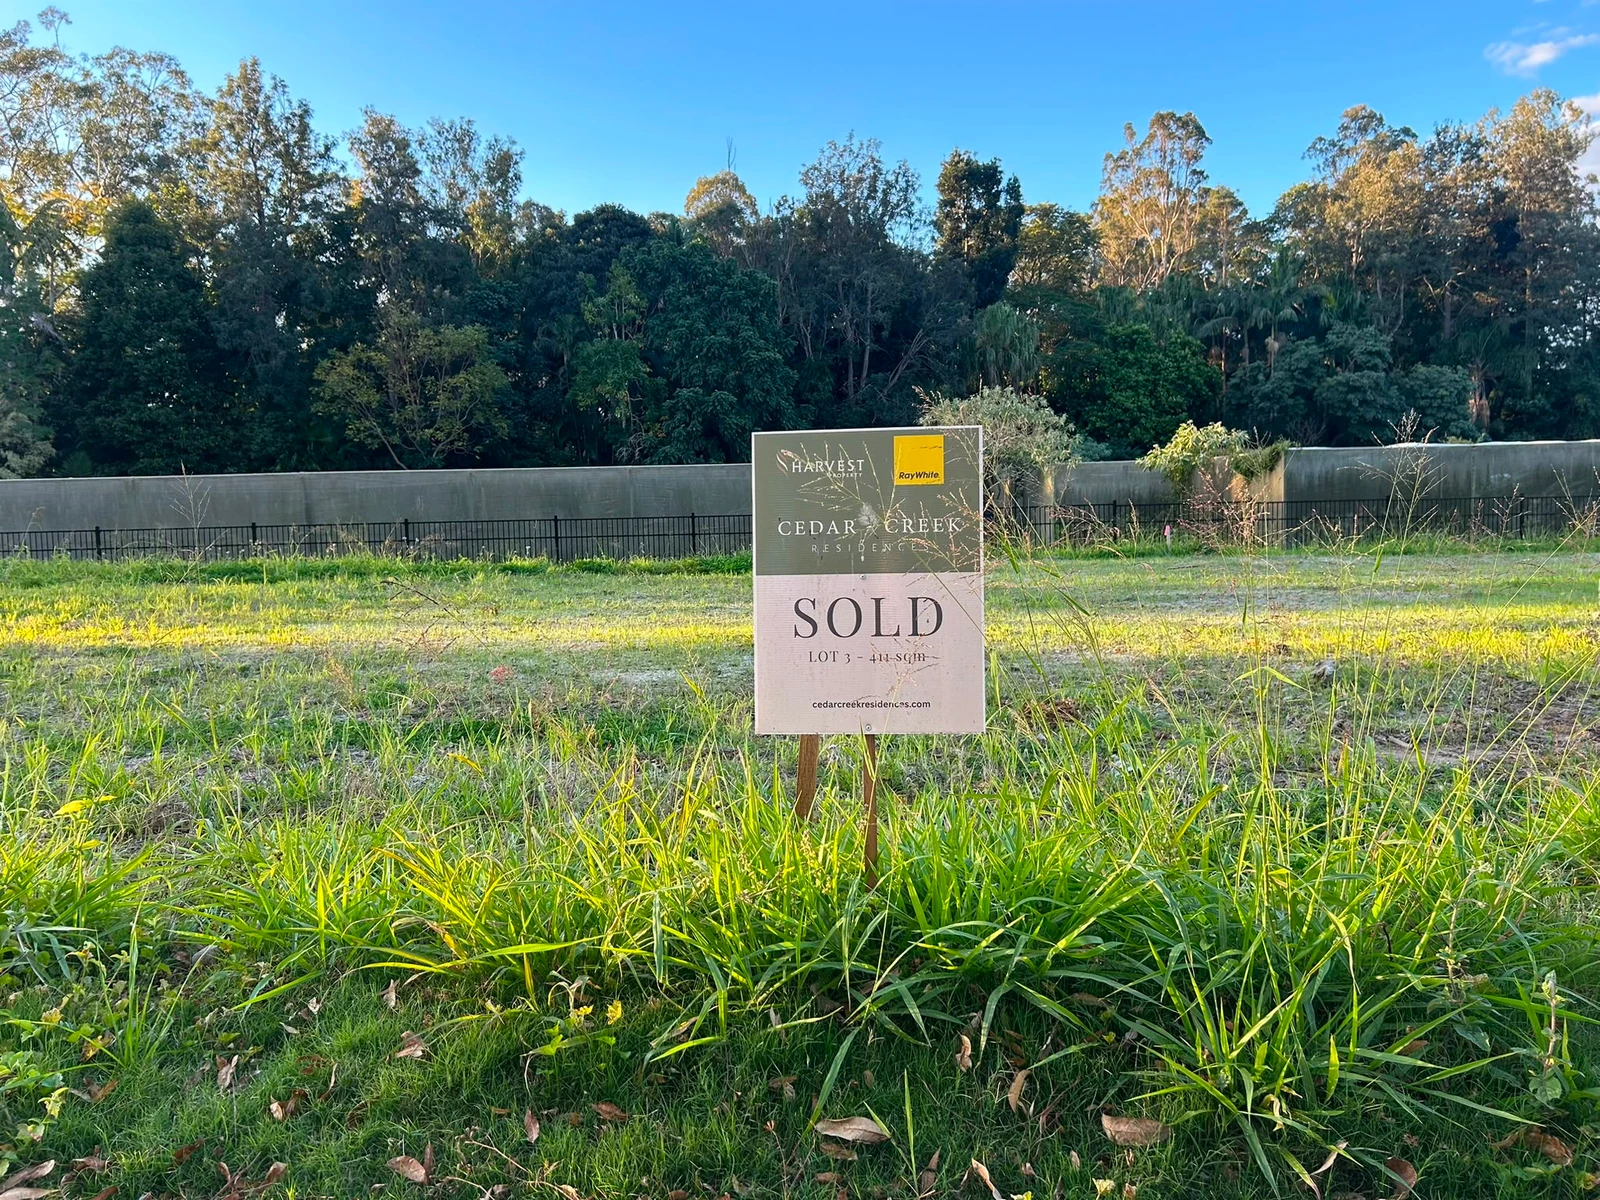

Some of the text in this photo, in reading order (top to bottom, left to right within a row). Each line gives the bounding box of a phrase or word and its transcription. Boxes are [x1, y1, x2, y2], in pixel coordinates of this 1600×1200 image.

[792, 460, 864, 472] HARVEST
[778, 517, 962, 536] CEDAR CREEK
[812, 543, 929, 553] RESIDENCES
[794, 597, 943, 639] SOLD
[809, 651, 839, 662] LOT
[844, 653, 851, 664] 3
[895, 652, 926, 664] sqm
[812, 700, 931, 709] cedarcreekresidences.com
